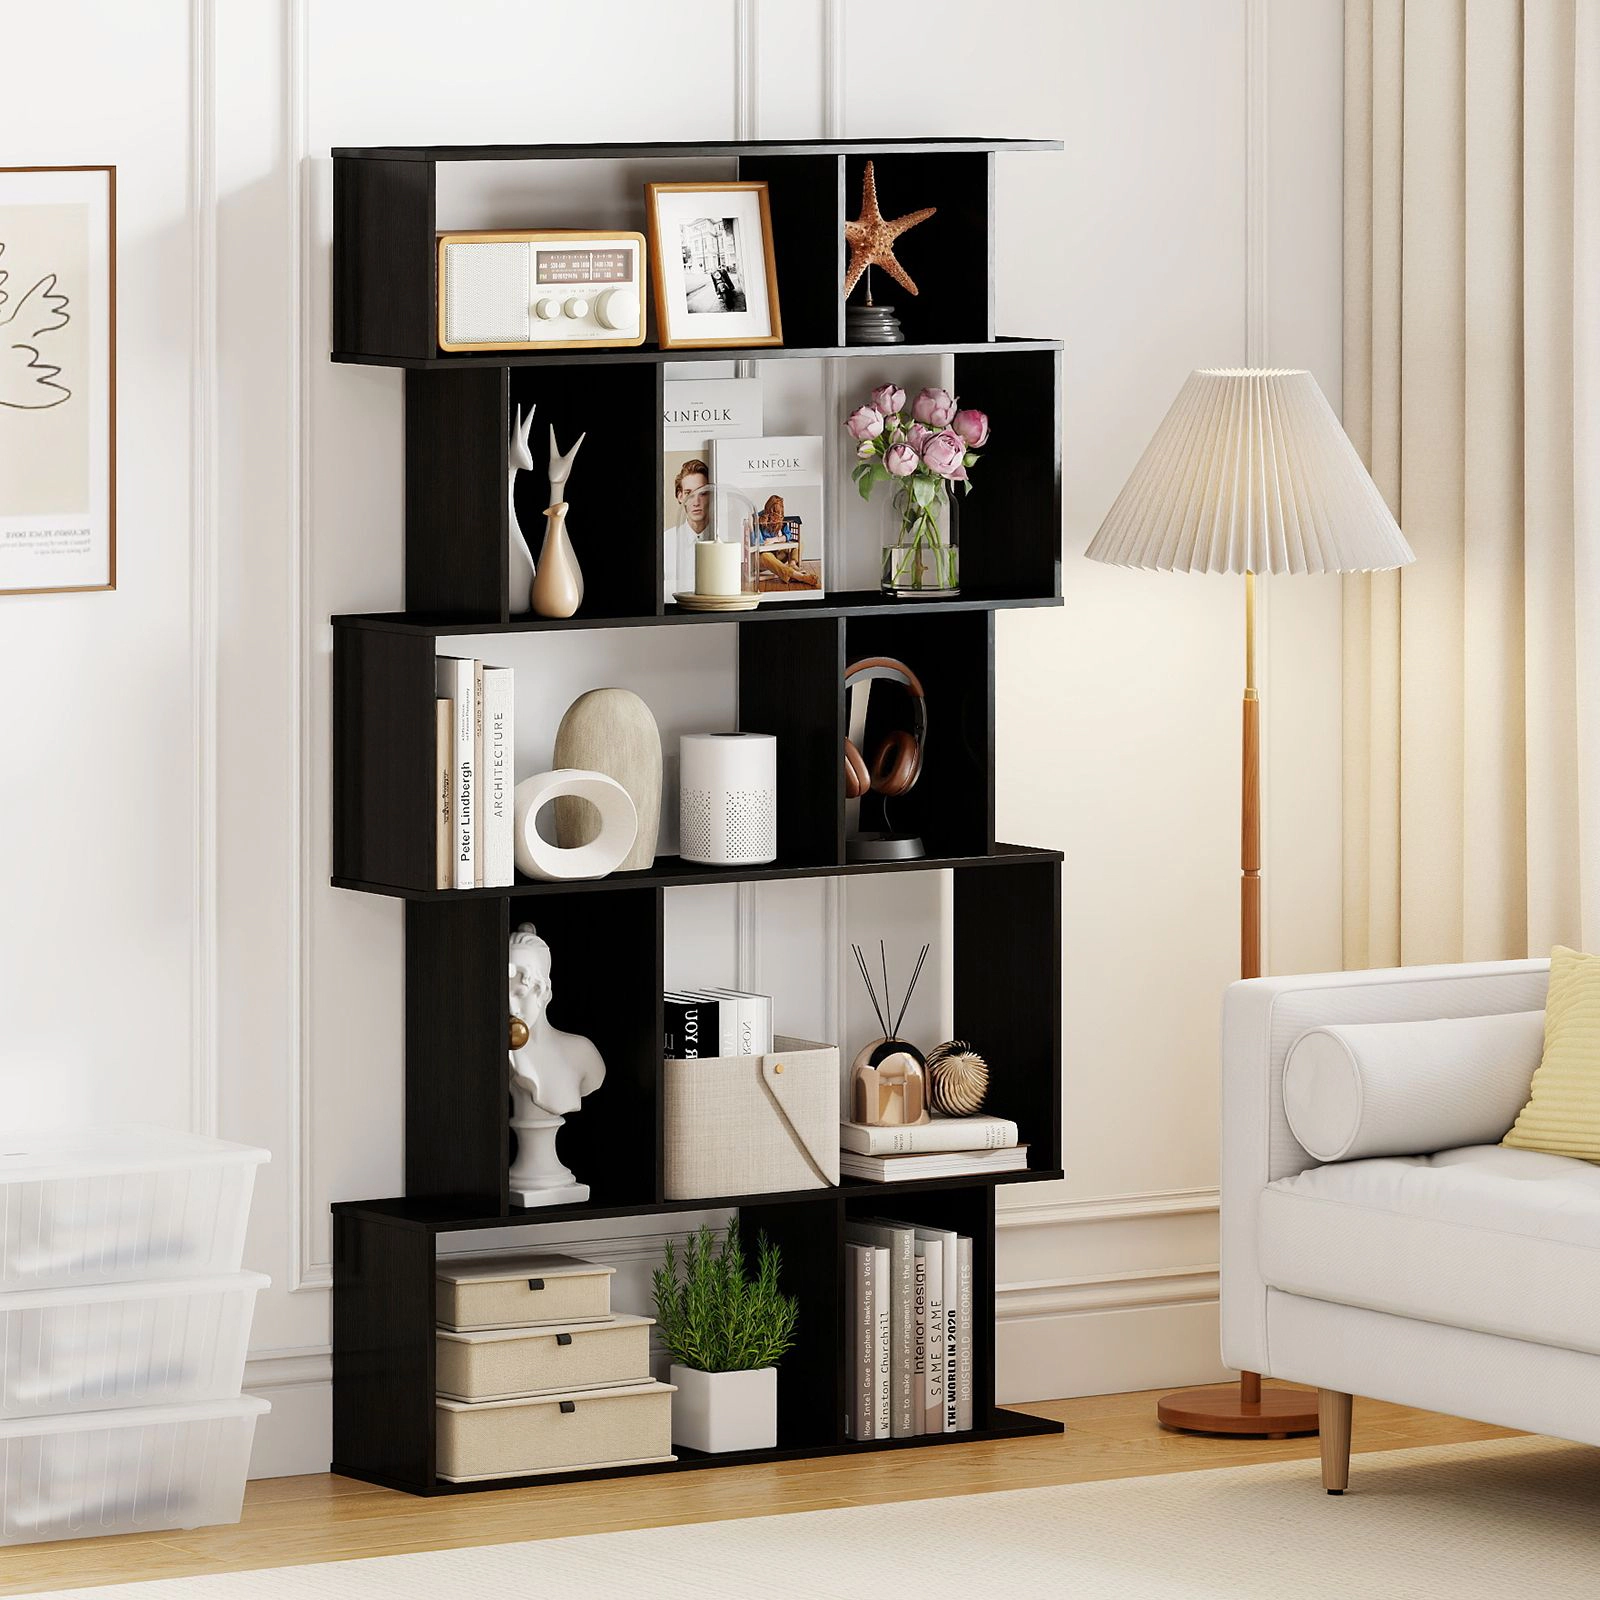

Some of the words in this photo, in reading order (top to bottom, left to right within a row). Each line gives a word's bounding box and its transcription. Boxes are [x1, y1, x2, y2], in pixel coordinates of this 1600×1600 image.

[664, 408, 732, 422] KINFOLK
[748, 458, 800, 469] KINFOLK
[494, 712, 503, 818] ARCHITECTURE
[461, 761, 472, 825] Lindbergh
[461, 829, 470, 862] Peter
[864, 1290, 872, 1325] Hawking
[903, 1285, 910, 1294] in
[914, 1264, 925, 1315] design
[962, 1265, 971, 1328] DECORATES
[880, 1311, 889, 1373] Churchill
[931, 1300, 942, 1342] SAME
[864, 1329, 872, 1363] Stephen
[905, 1359, 910, 1369] an
[914, 1320, 924, 1374] Interior
[948, 1344, 956, 1356] IN
[931, 1353, 942, 1395] SAME
[962, 1336, 971, 1400] HOUSEHOLD
[880, 1381, 889, 1430] Winston
[904, 1399, 910, 1408] to
